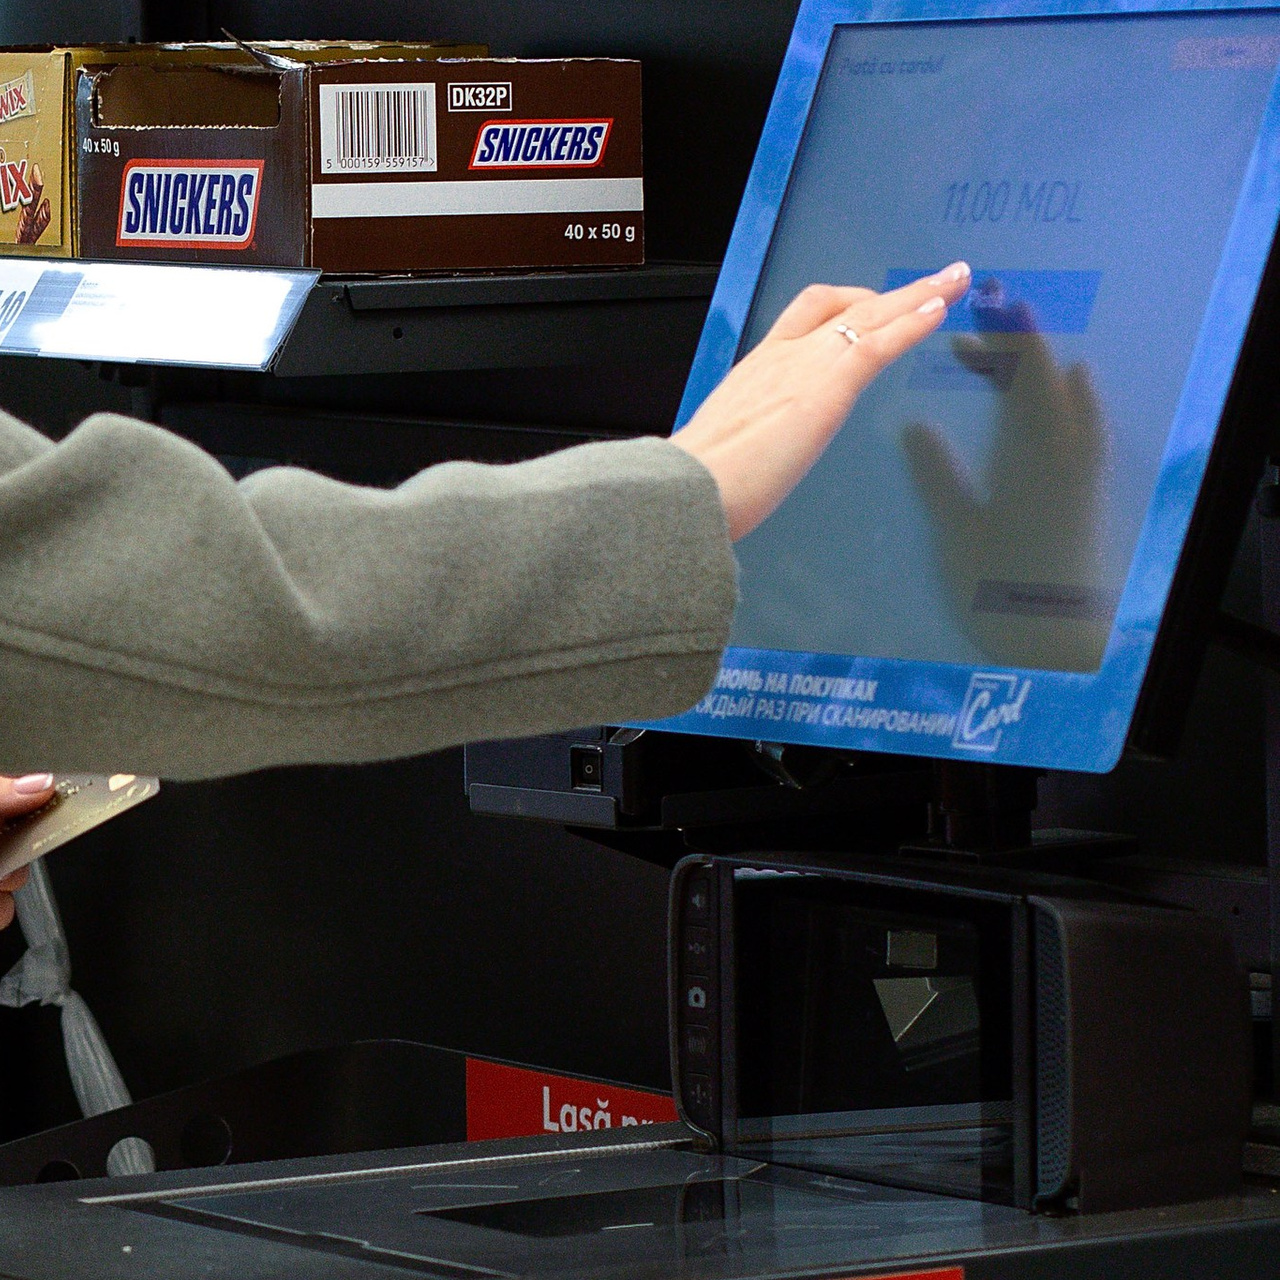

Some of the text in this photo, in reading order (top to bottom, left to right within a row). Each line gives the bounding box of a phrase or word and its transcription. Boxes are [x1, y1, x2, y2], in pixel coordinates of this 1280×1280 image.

[452, 87, 507, 108] DK32P
[82, 138, 93, 153] 40
[100, 138, 112, 154] 50
[113, 141, 120, 157] g
[477, 126, 605, 163] SNICKERS
[124, 172, 255, 237] SNICKERS
[1016, 179, 1083, 222] MDL
[564, 223, 636, 242] 40 x 50 g
[763, 673, 787, 694] НА
[787, 675, 879, 702] ПОКУПКАХ
[756, 698, 956, 736] РАЗ ПРИ СКАНИРОВАНИИ
[542, 1085, 612, 1133] Lasă
